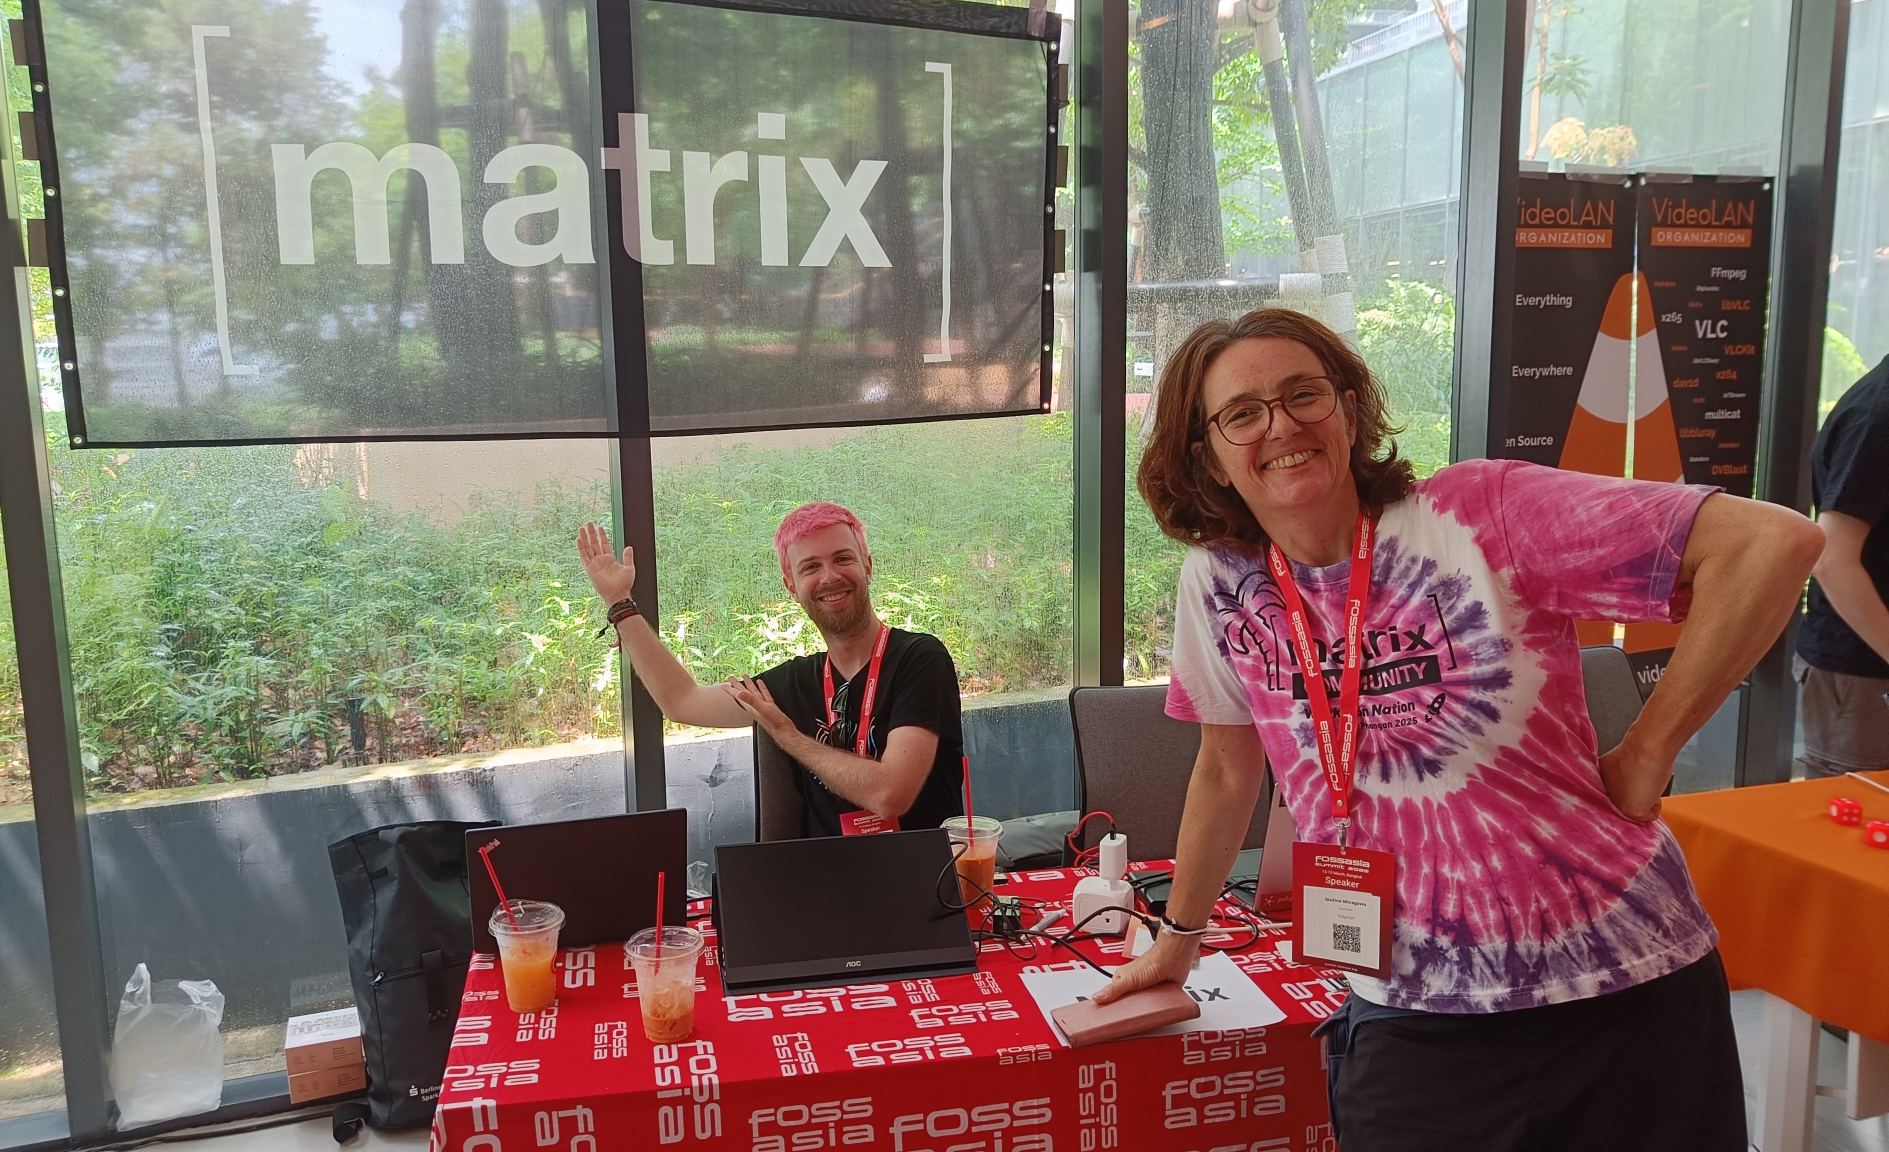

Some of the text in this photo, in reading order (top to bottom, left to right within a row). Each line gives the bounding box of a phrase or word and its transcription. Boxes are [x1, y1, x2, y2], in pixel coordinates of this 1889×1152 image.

[1516, 198, 1616, 226] ideoLAN
[1652, 199, 1755, 226] VideoLAN
[1516, 232, 1606, 245] RGANIZATION
[1657, 231, 1746, 243] ORGANIZATION
[1710, 267, 1748, 280] FFmpeg
[1515, 293, 1573, 309] Everything
[1661, 312, 1683, 324] x265
[1695, 319, 1729, 339] VLC
[1512, 364, 1574, 380] Everywhere
[1705, 409, 1741, 420] multicat
[1517, 435, 1554, 447] Source
[1372, 700, 1416, 717] Nation
[1394, 716, 1418, 728] 2025
[1325, 876, 1360, 889] Speaker
[420, 1086, 441, 1095] Berlin
